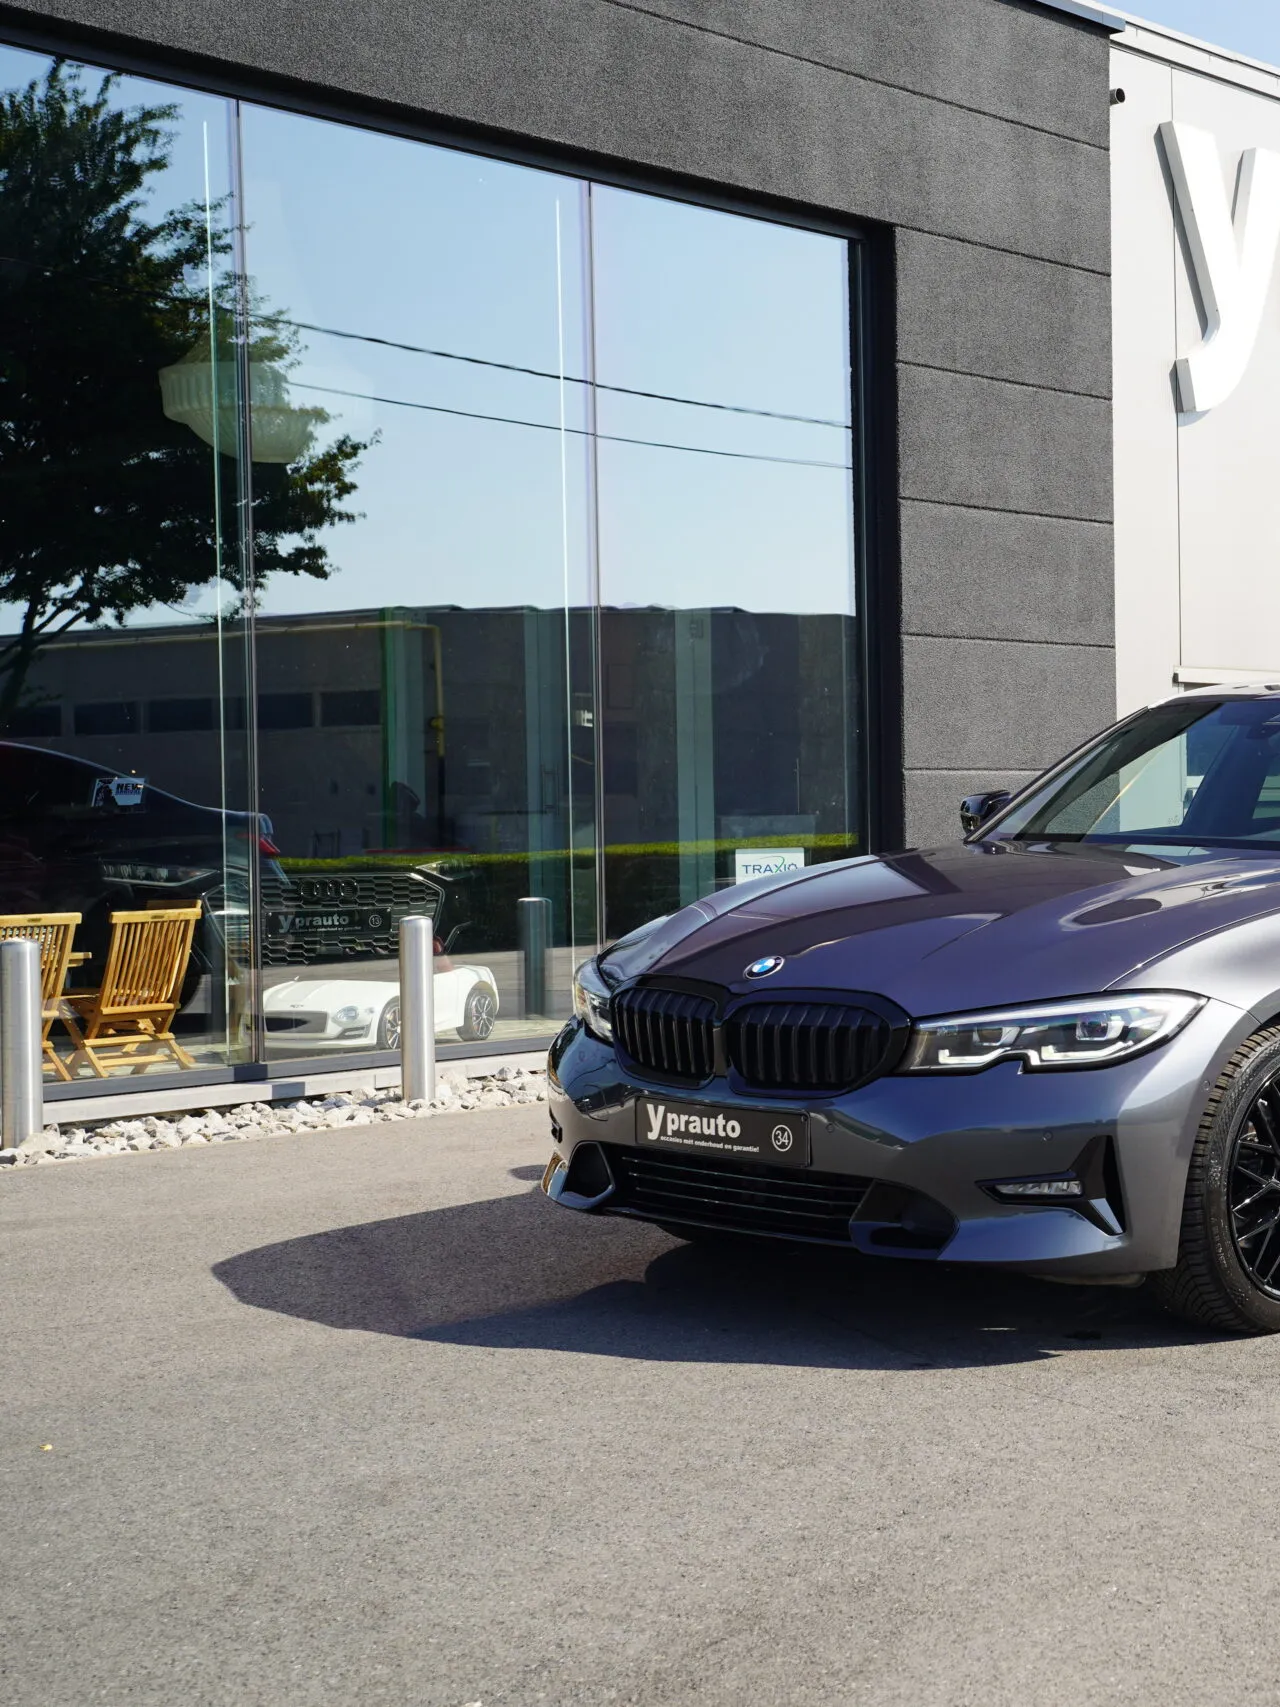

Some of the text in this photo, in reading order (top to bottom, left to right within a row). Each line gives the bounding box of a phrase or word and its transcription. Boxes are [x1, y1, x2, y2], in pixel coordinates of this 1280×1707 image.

[646, 1103, 741, 1139] yprauto
[694, 1139, 724, 1149] onderhoud
[775, 1130, 789, 1145] 34
